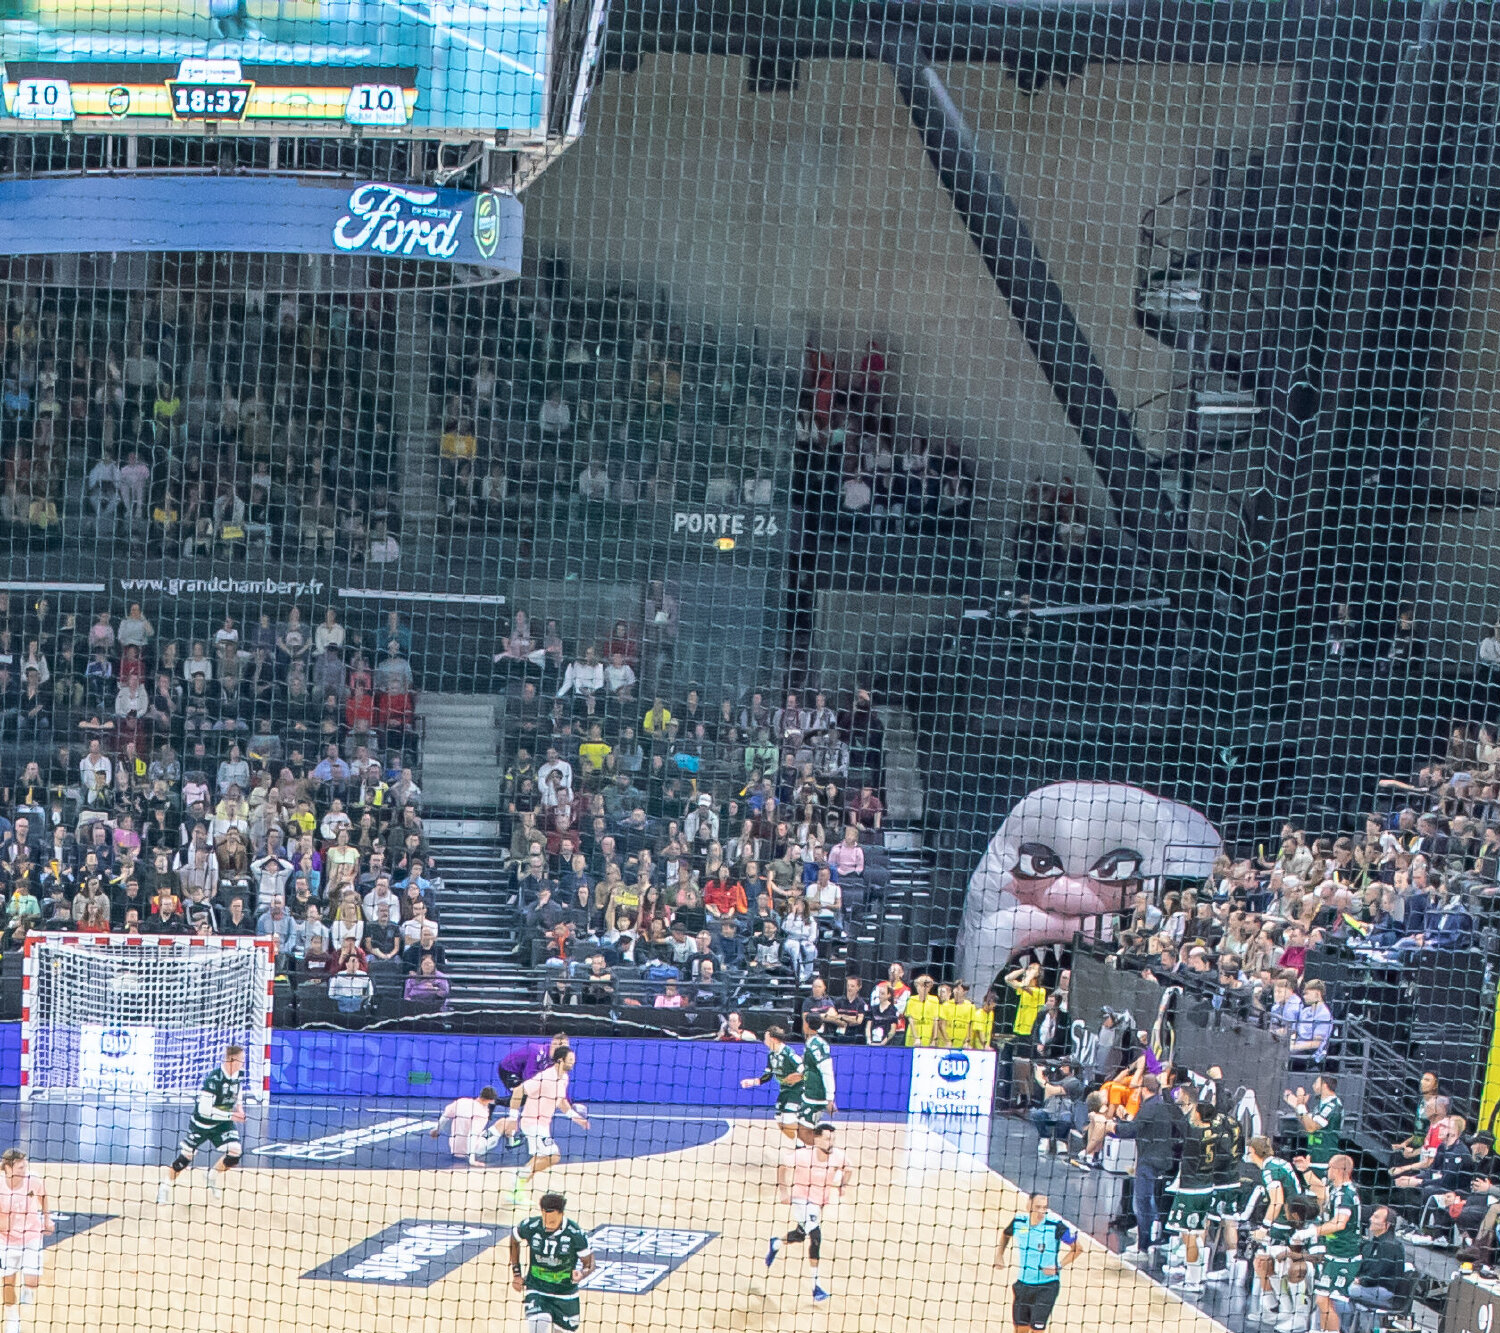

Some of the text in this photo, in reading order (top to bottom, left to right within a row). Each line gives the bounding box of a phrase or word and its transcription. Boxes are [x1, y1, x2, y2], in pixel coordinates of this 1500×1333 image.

[27, 85, 58, 106] 10
[175, 89, 248, 114] 18:37
[360, 89, 393, 110] 10
[333, 183, 462, 258] Ford
[673, 512, 779, 536] PORTE 26
[120, 577, 324, 597] www.grandchambery.fr
[936, 1087, 967, 1101] Best
[543, 1241, 558, 1255] 17
